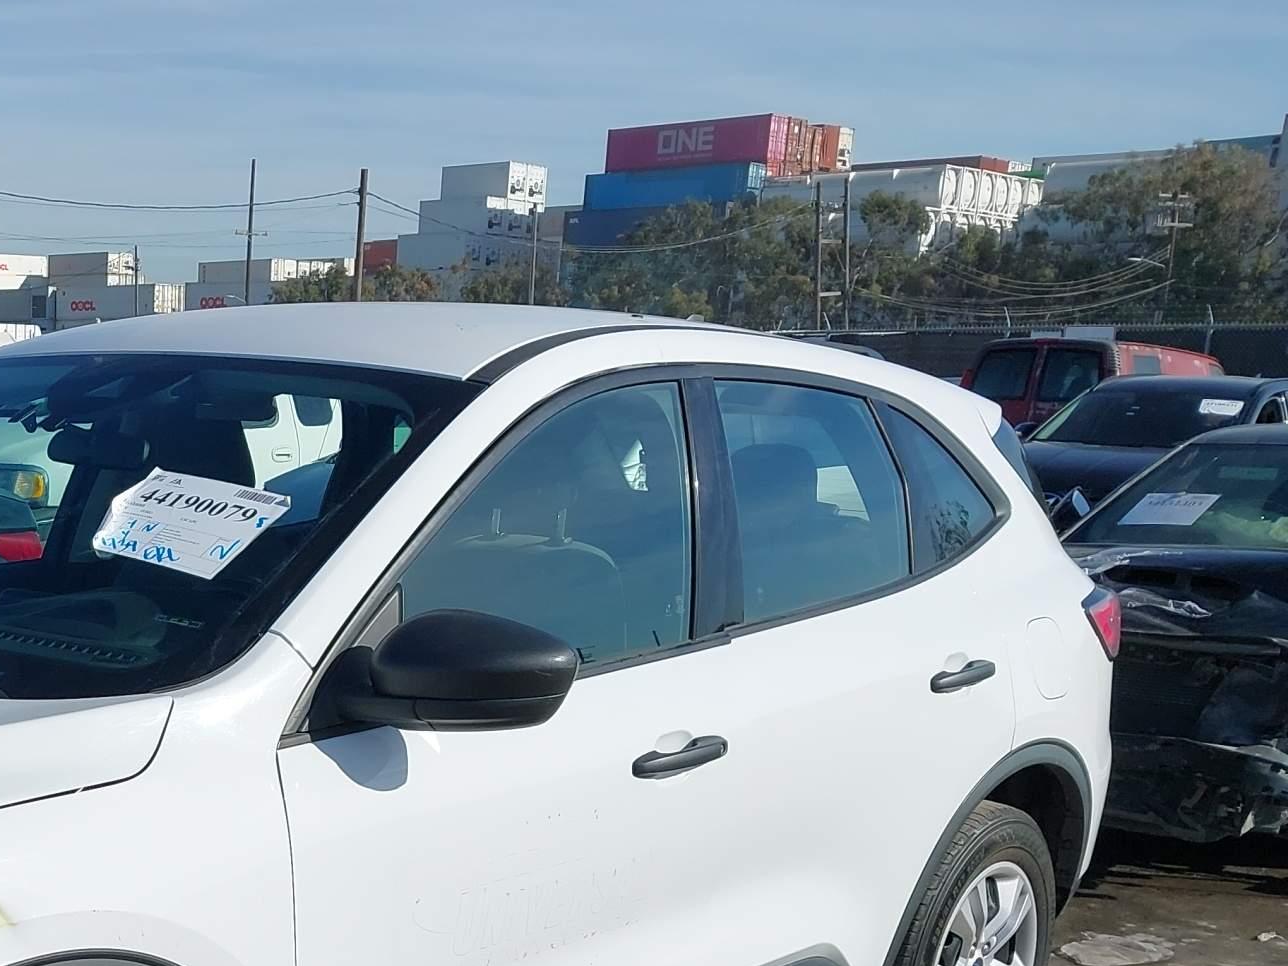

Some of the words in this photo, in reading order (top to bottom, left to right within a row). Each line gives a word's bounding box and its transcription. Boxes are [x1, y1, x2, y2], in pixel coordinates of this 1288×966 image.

[656, 125, 715, 154] ONE
[70, 300, 97, 311] OOCL
[140, 489, 259, 522] 44190079
